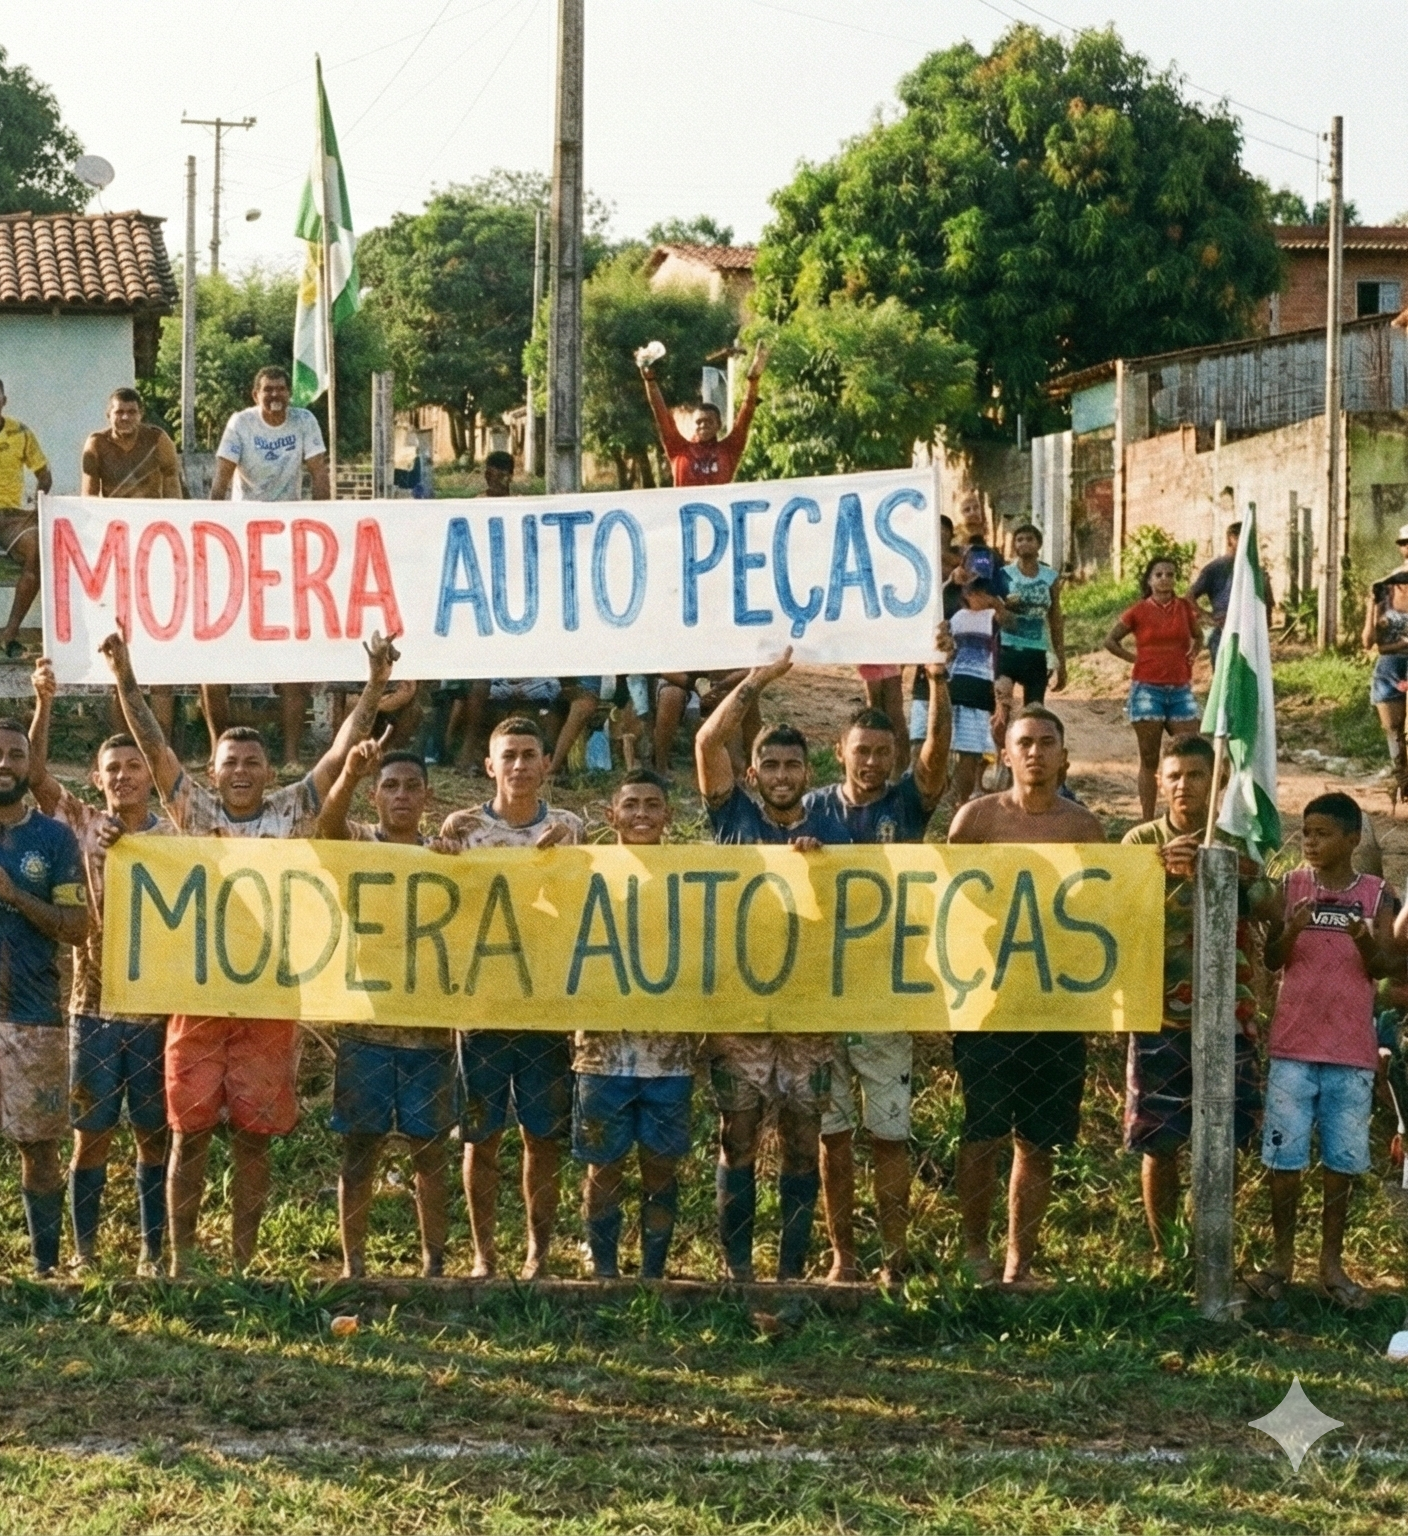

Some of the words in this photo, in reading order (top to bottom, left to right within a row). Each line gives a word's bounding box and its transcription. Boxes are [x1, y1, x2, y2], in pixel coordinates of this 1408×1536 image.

[51, 517, 405, 643] MODERA
[434, 509, 647, 635] AUTO
[678, 487, 932, 638] PEÇAS
[127, 862, 534, 998] MODERA
[565, 870, 801, 998] AUTO
[831, 868, 1119, 1010] PEÇAS
